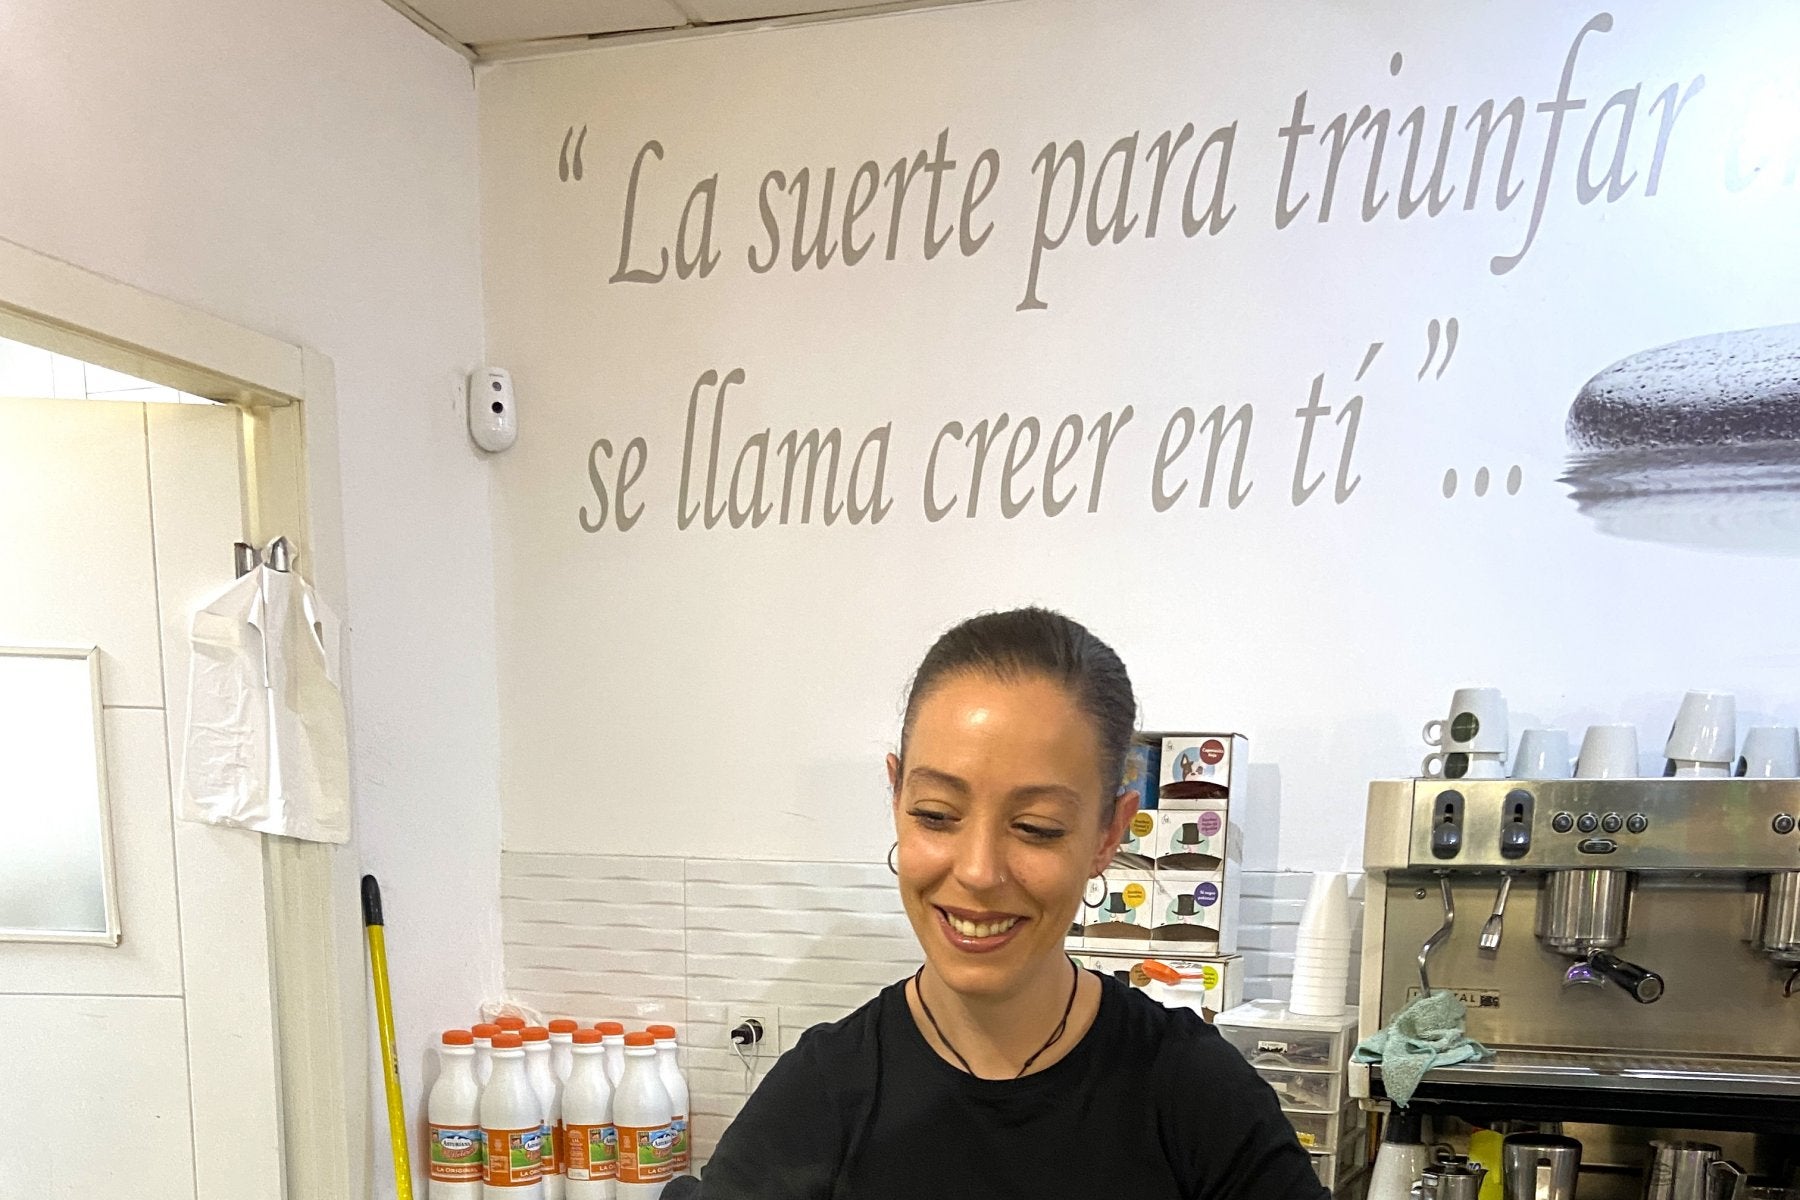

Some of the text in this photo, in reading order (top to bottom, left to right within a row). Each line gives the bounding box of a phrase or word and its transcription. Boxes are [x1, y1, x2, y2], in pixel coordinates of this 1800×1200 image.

[608, 140, 721, 284] La
[748, 127, 1001, 273] suerte
[1015, 119, 1238, 312] para
[1275, 12, 1706, 276] triunfar
[579, 437, 648, 533] se
[677, 368, 894, 531] llama
[923, 405, 1135, 523] creer
[1152, 403, 1254, 514] en
[1290, 342, 1384, 507] tí
